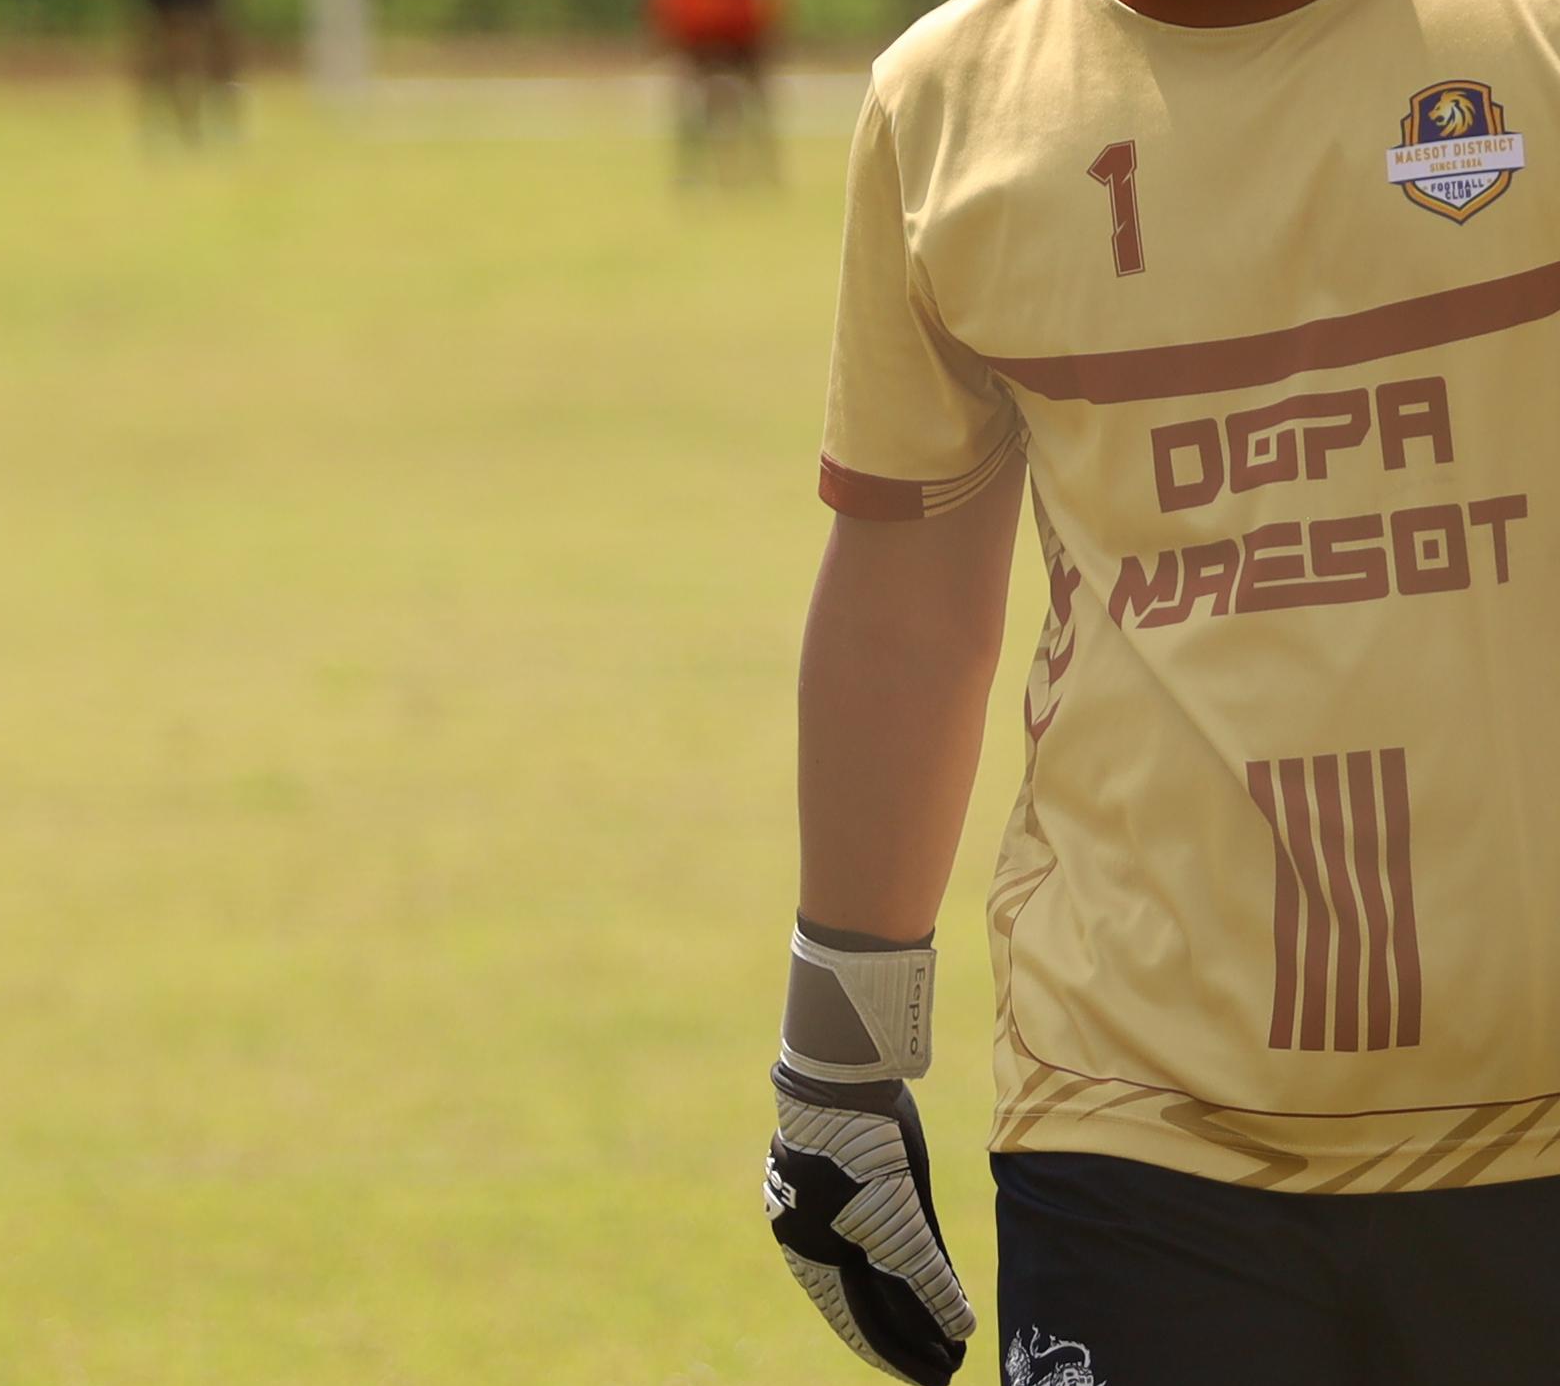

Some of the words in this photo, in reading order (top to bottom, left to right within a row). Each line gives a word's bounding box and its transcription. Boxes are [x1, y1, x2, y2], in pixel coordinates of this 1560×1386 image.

[1395, 145, 1448, 164] MAESOT
[1454, 138, 1514, 156] DISTRICT
[1431, 161, 1457, 172] SINCE
[1431, 179, 1484, 192] FOOTBALL
[1445, 190, 1471, 200] CLUB
[1086, 139, 1145, 278] 1
[1150, 376, 1454, 514] DOPA
[1108, 493, 1528, 632] MAESOT
